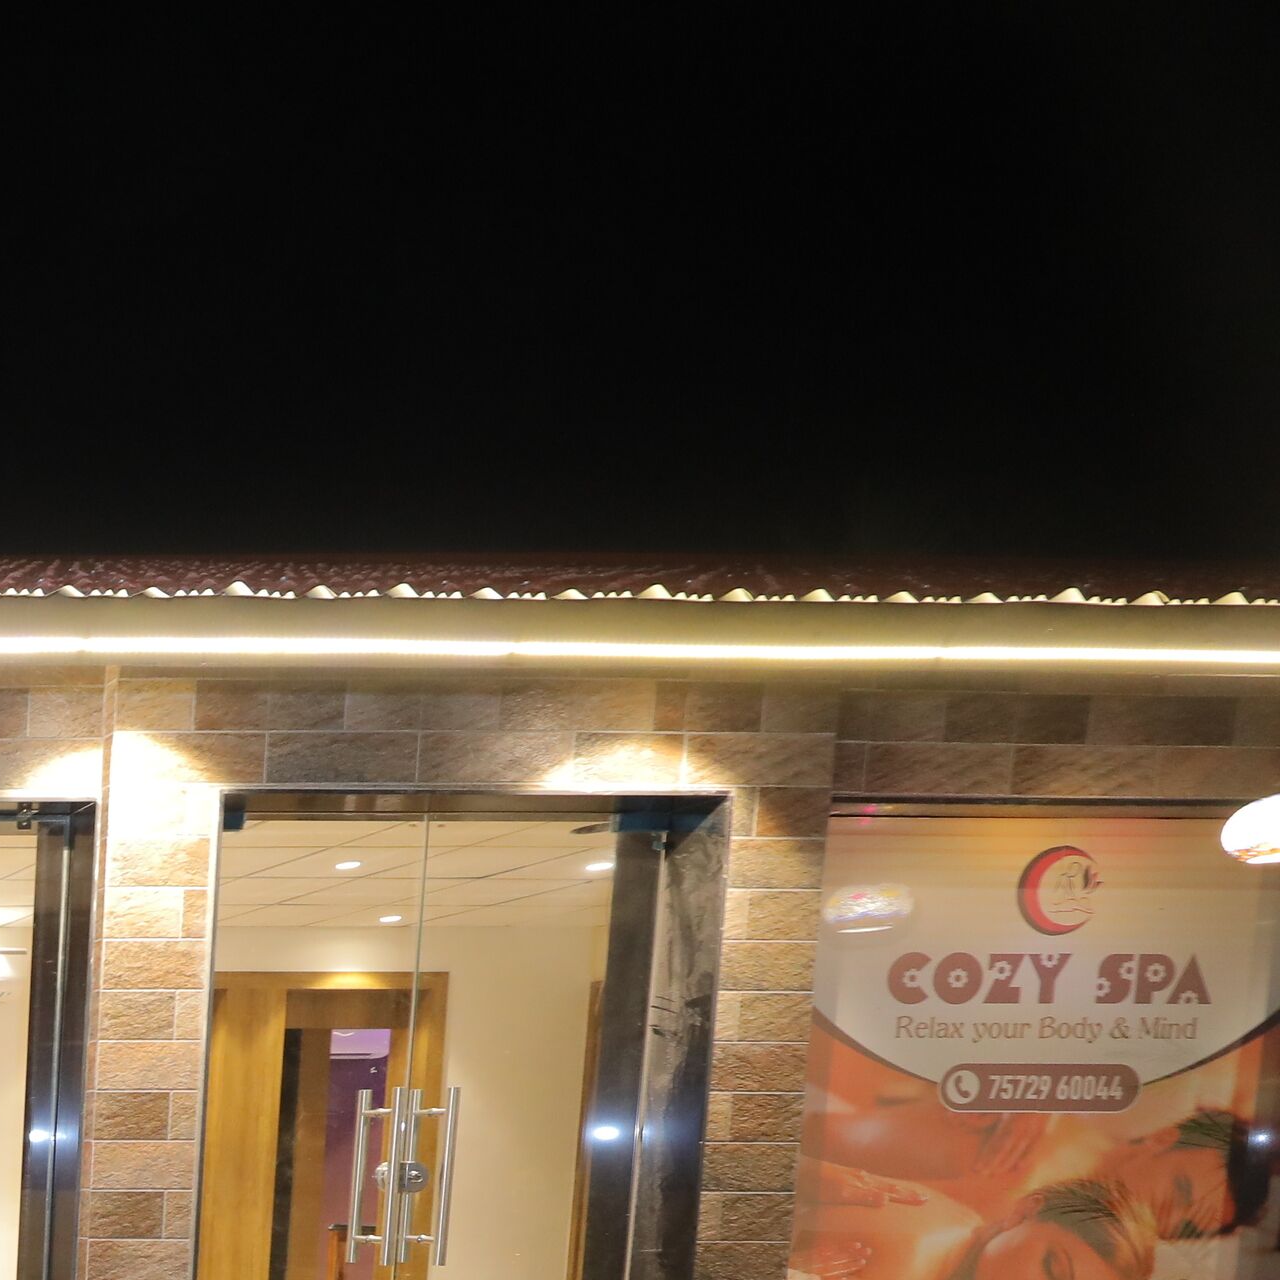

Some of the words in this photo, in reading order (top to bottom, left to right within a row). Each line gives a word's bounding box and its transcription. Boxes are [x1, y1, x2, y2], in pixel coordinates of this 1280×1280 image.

[887, 951, 1073, 1005] COZY
[1095, 953, 1212, 1005] SPA
[894, 1015, 965, 1039] Relax
[972, 1022, 1032, 1043] your
[1037, 1015, 1104, 1043] Body
[1109, 1016, 1130, 1040] &
[1137, 1016, 1199, 1040] Mind
[987, 1074, 1049, 1100] 75729
[1056, 1074, 1124, 1100] 60044
